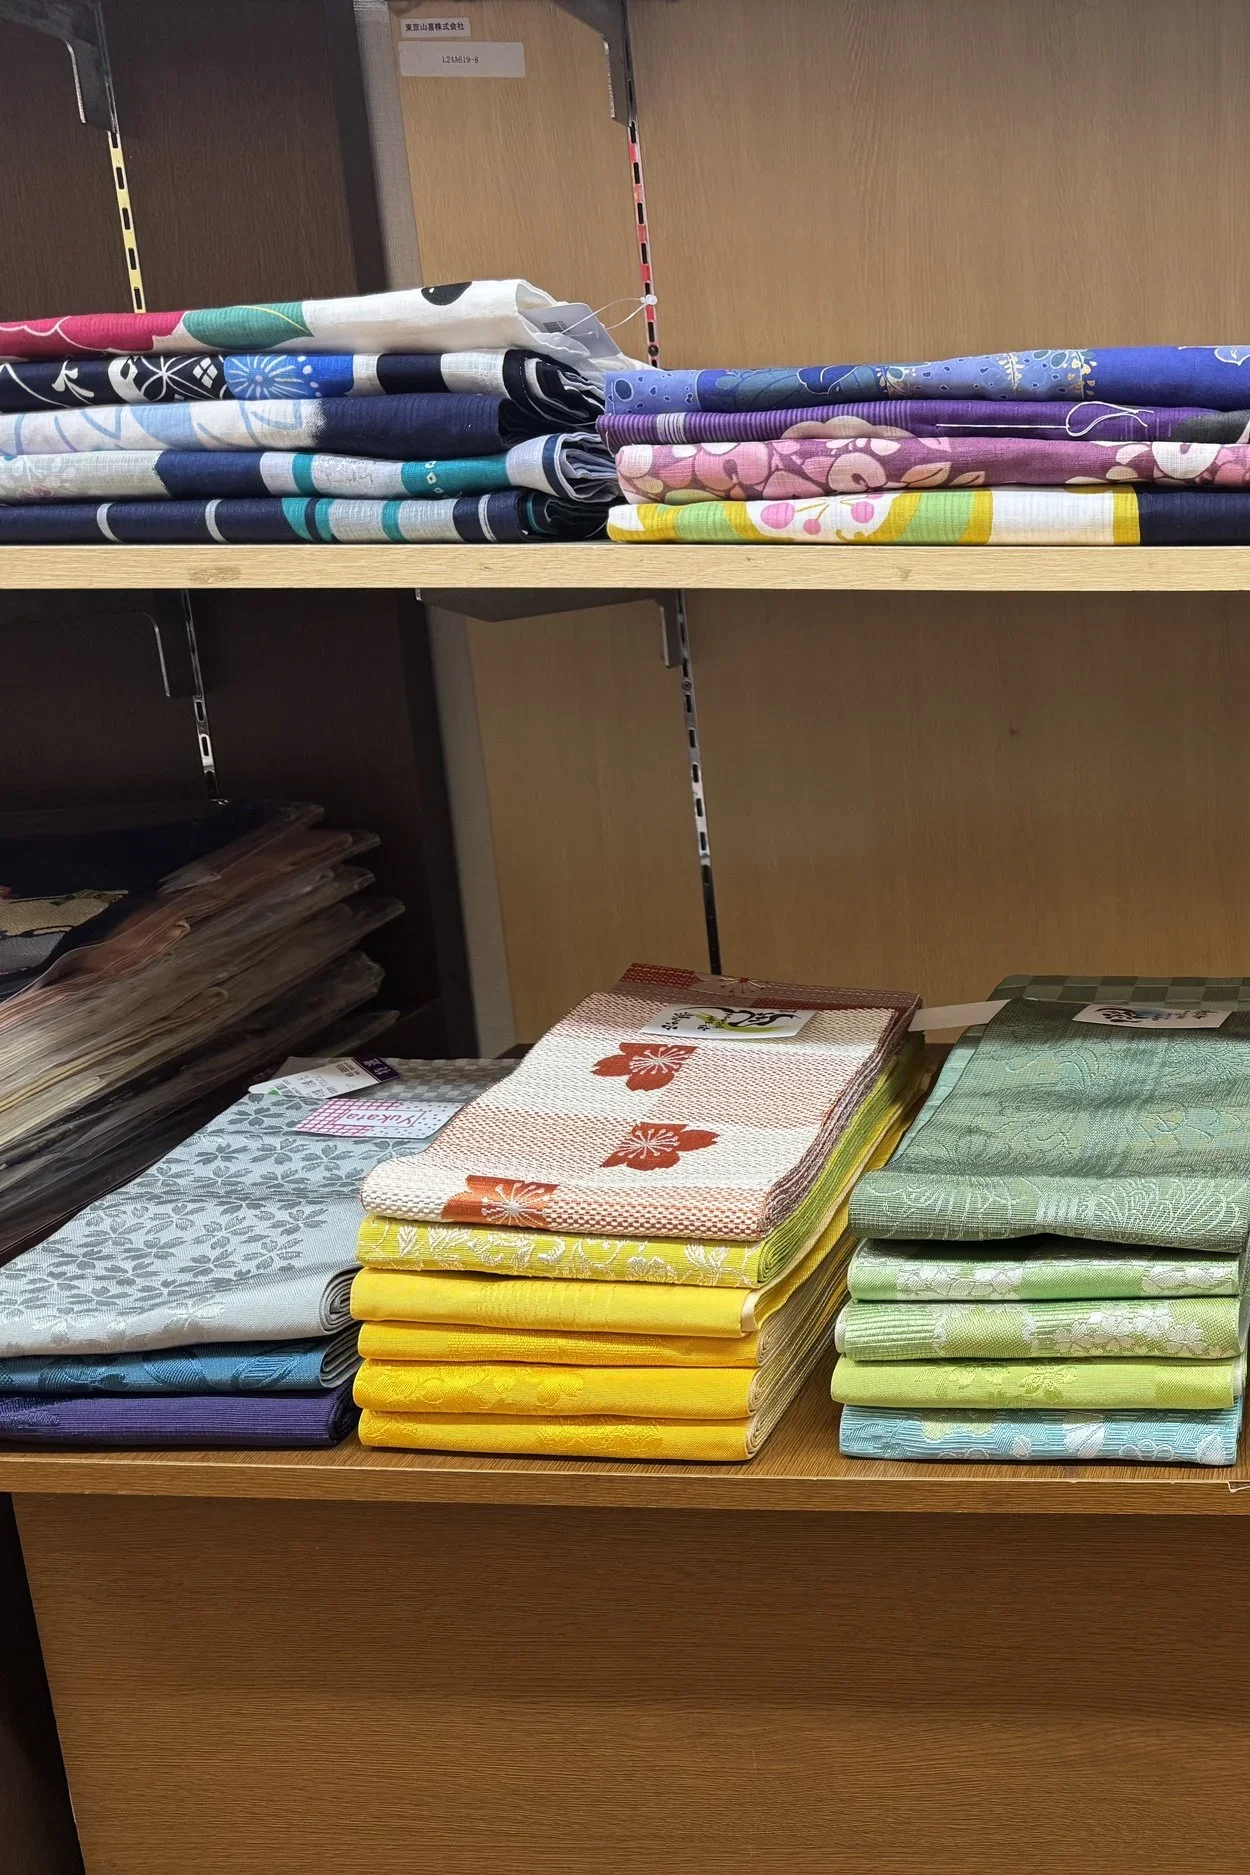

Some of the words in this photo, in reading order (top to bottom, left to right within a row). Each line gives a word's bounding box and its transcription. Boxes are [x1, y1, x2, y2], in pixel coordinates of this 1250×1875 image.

[405, 22, 465, 32] 東京山喜株式会社
[346, 1112, 415, 1126] Yukata
